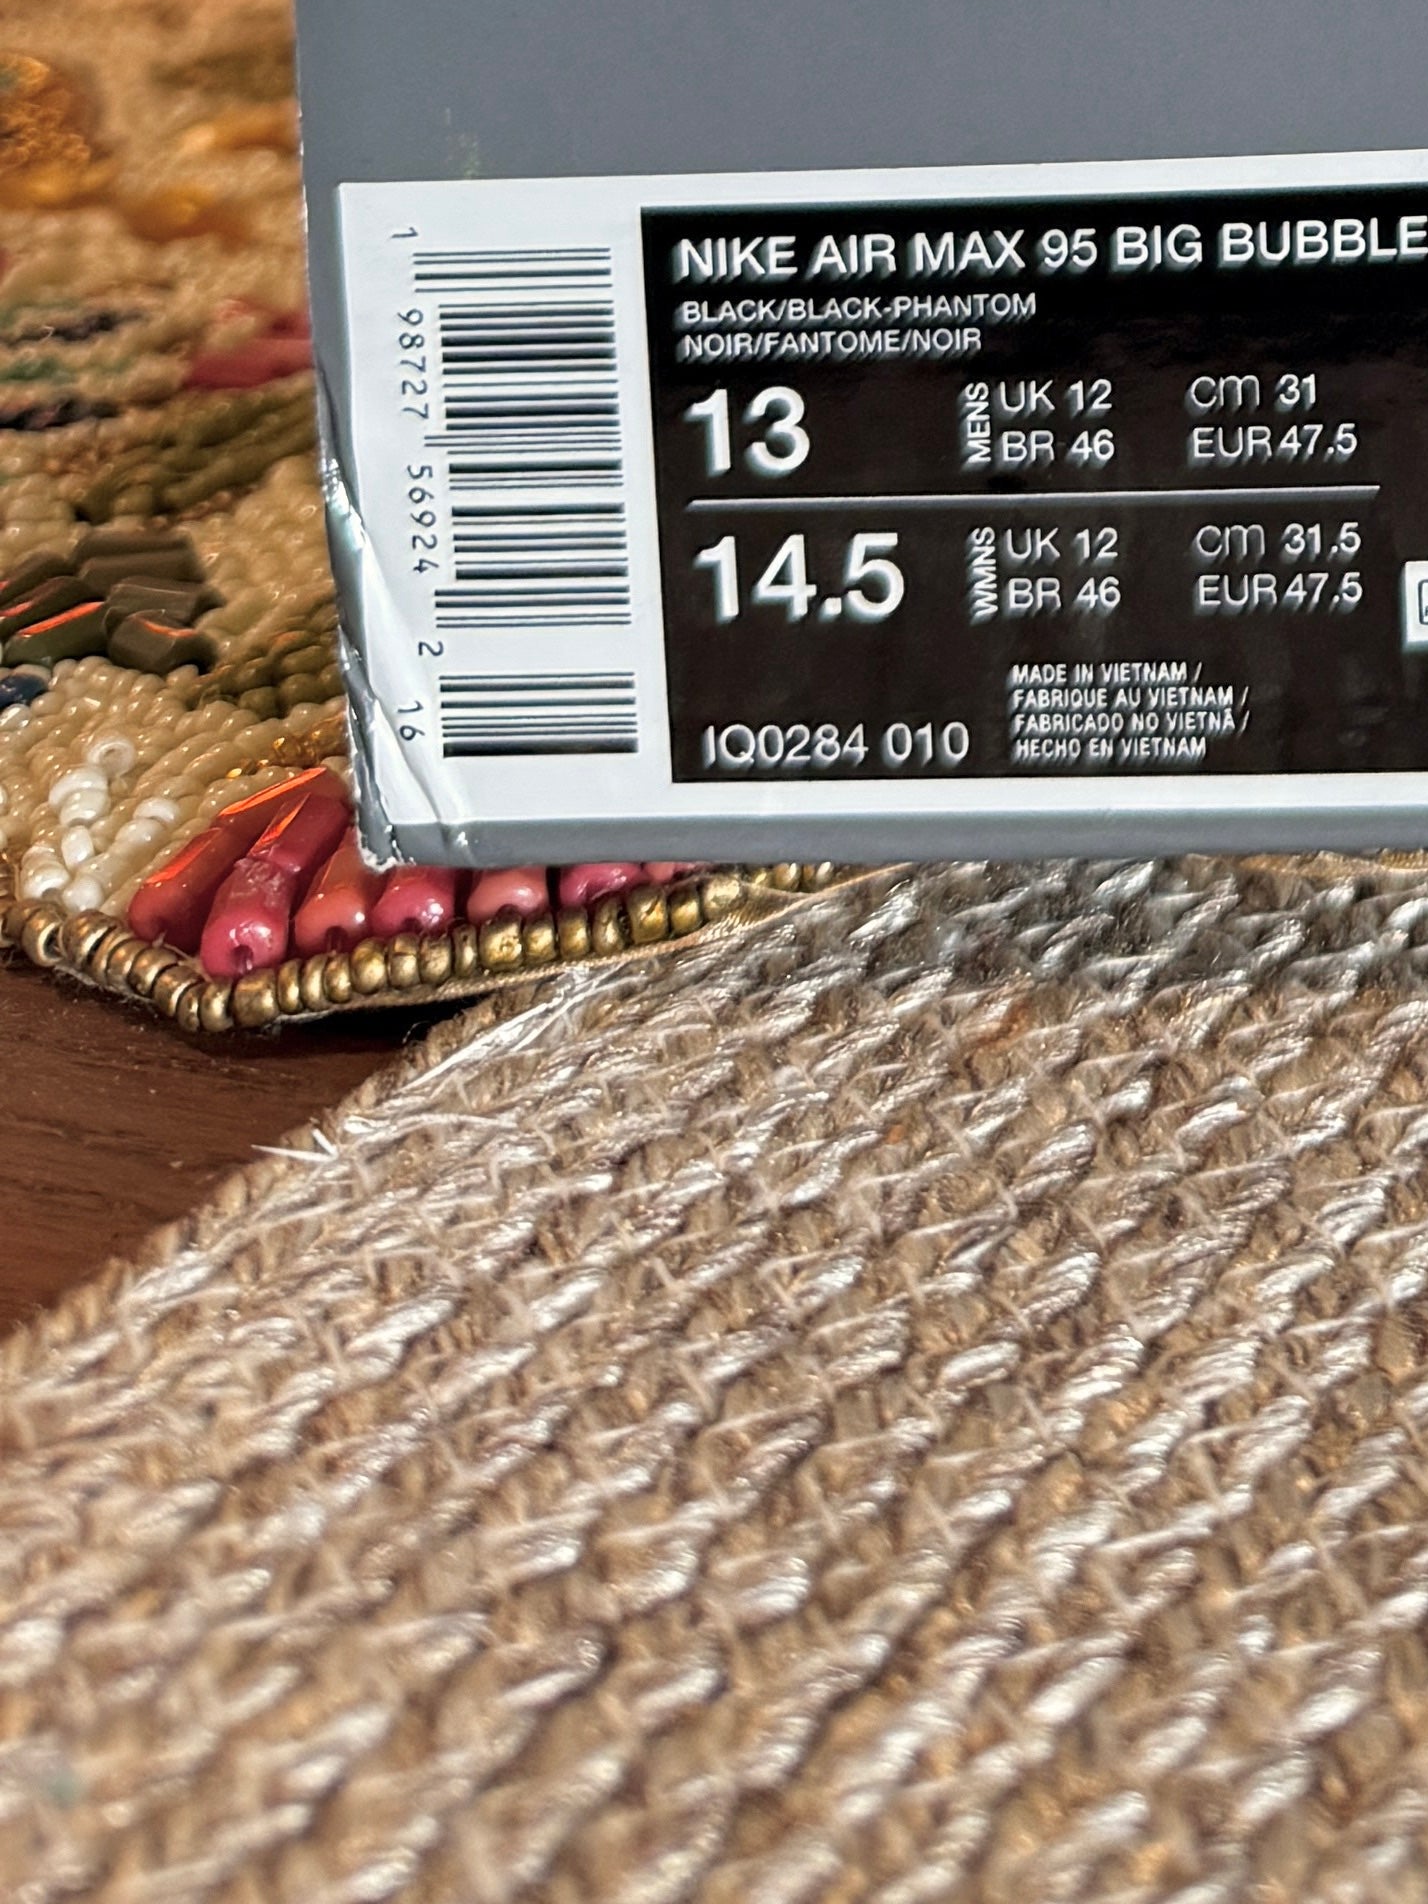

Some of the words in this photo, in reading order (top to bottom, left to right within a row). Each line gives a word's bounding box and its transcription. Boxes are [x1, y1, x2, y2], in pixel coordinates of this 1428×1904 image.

[390, 226, 419, 240] 1
[678, 235, 798, 278] NIKE
[810, 232, 897, 274] AIR
[912, 228, 1026, 272] MAX
[1040, 227, 1097, 269] 95
[1115, 223, 1203, 265] BIG
[681, 292, 1037, 325] BLACK/BLACK-PHANTOM
[682, 327, 982, 358] NOIR/FANTOME/NOIR
[397, 308, 430, 420] 98727
[1000, 379, 1055, 413] UK
[1069, 378, 1113, 410] 12
[1277, 373, 1317, 405] 31
[688, 385, 811, 473] 13
[965, 381, 991, 464] MENS
[1001, 429, 1055, 463] BR
[1071, 427, 1116, 461] 46
[1192, 424, 1273, 459] EUR
[1278, 422, 1359, 456] 47.5
[407, 464, 440, 575] 56924
[1006, 527, 1061, 560] UK
[1076, 526, 1120, 559] 12
[1283, 521, 1362, 555] 31.5
[698, 531, 905, 618] 14.5
[970, 526, 999, 617] WMNS
[1198, 573, 1278, 607] EUR
[1285, 571, 1363, 604] 47.5
[1007, 576, 1062, 610] BR
[1077, 575, 1121, 608] 46
[417, 640, 444, 658] 2
[1011, 663, 1068, 683] MADE
[1075, 663, 1094, 682] IN
[1100, 662, 1188, 682] VIETNAM
[1012, 687, 1108, 708] FABRIQUE
[1115, 687, 1142, 706] AU
[1149, 685, 1234, 707] VIETNAM
[397, 699, 426, 742] 16
[1014, 712, 1124, 733] FABRICADO
[1131, 712, 1160, 732] NO
[1166, 708, 1236, 731] VIETNÃ
[704, 722, 870, 765] IQ0284
[886, 720, 970, 762] 010
[1016, 737, 1082, 758] HECHO
[1089, 737, 1114, 757] EN
[1121, 736, 1207, 757] VIETNAM
